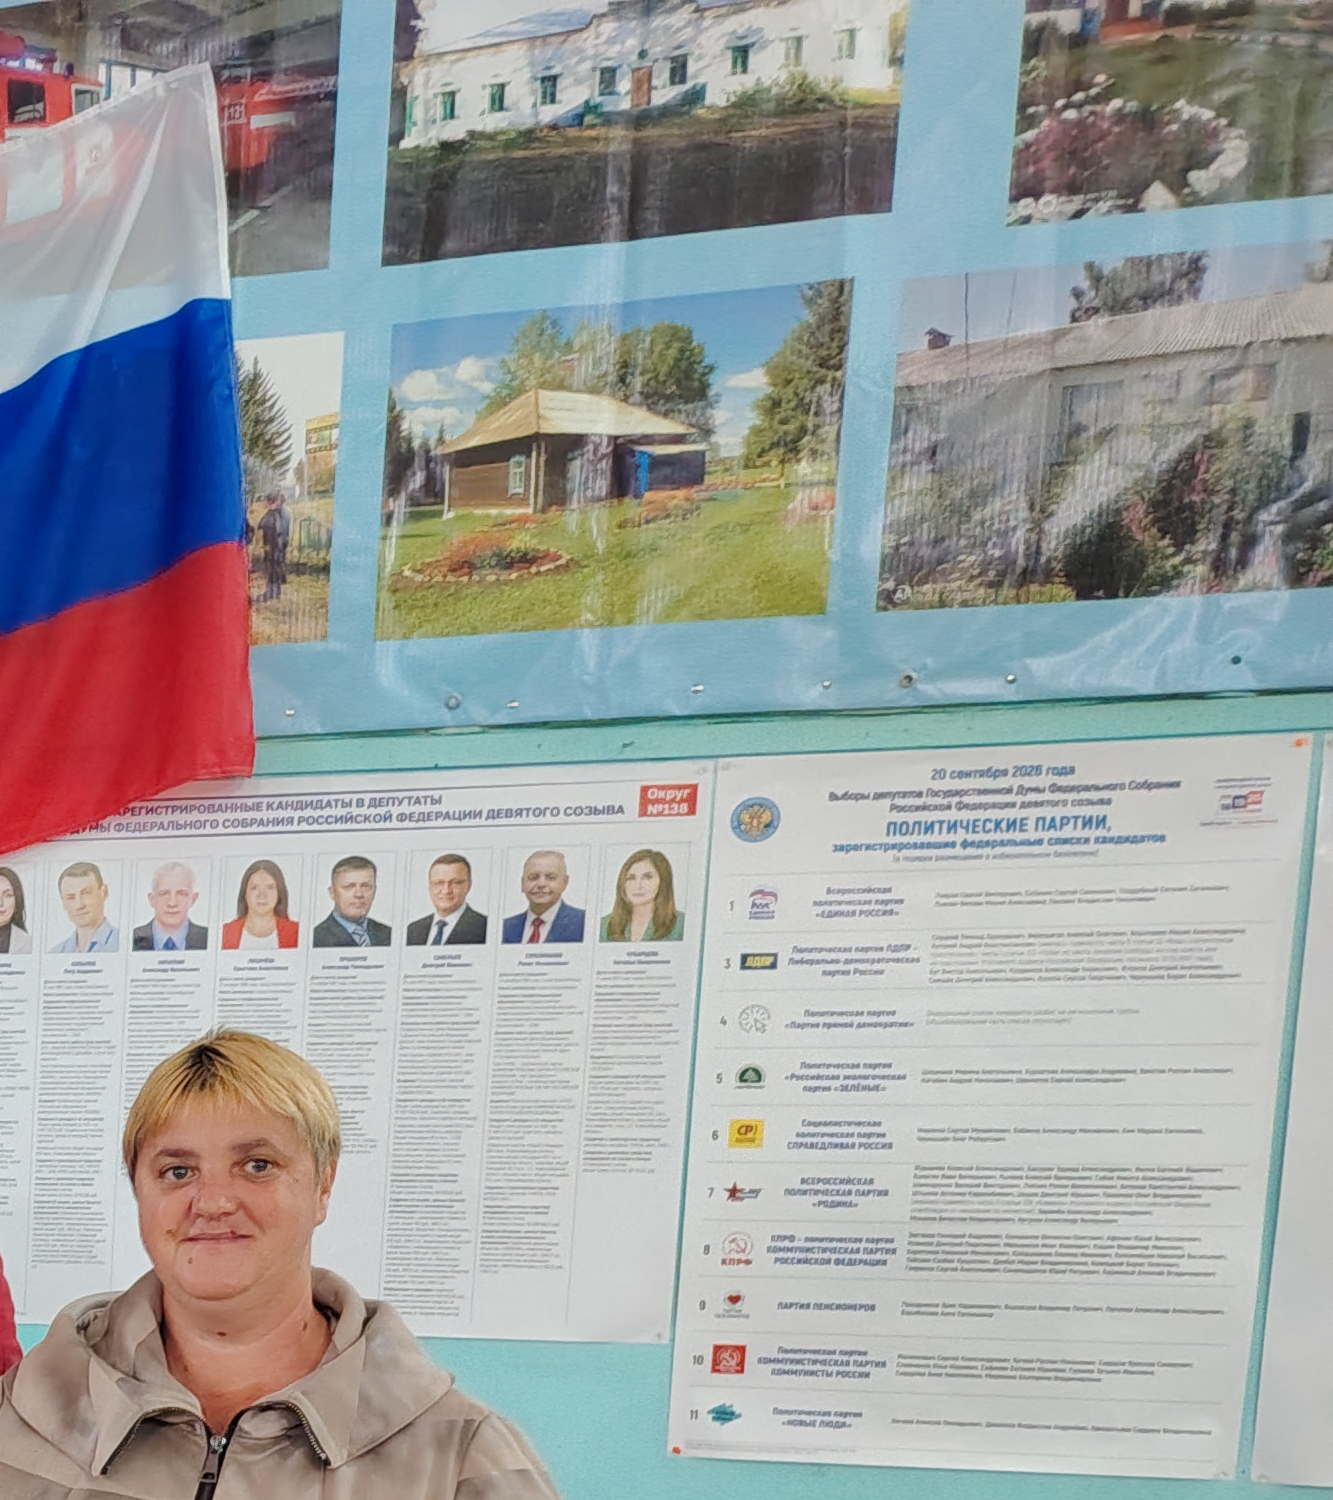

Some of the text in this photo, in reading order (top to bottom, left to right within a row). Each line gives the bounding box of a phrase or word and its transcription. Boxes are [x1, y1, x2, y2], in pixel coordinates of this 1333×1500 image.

[930, 768, 946, 781] 20
[949, 766, 1008, 781] сентября
[1045, 765, 1076, 778] года
[646, 788, 691, 801] Округ
[828, 790, 871, 803] Выборы
[925, 785, 1014, 800] Государственной
[1015, 784, 1046, 797] Думы
[1048, 780, 1126, 794] Федерального
[1127, 779, 1182, 792] Собрания
[113, 794, 443, 818] РЕГИСТРИРОВАННЫЕ КАНДИДАТЫ В ДЕПУТАТЫ
[889, 801, 952, 814] Российской
[954, 800, 1017, 812] Федерации
[113, 818, 220, 835] ФЕДЕРАЛЬНОГО
[222, 815, 295, 830] СОБРАНИЯ
[297, 811, 393, 827] РОССИЙСКОЙ
[396, 809, 483, 824] ФЕДЕРАЦИИ
[485, 806, 561, 821] ДЕВЯТОГО
[563, 804, 625, 818] СОЗЫВА
[885, 814, 1112, 837] ПОЛИТИЧЕСКИЕ ПАРТИИ,
[832, 832, 1167, 855] зарегистрировавшие федеральные списки кандидатов
[729, 901, 735, 912] 1
[724, 958, 731, 970] 3
[720, 1016, 728, 1027] 4
[716, 1073, 723, 1085] 5
[711, 1130, 720, 1141] 6
[707, 1187, 715, 1199] 7
[721, 1258, 753, 1267] КПРФ
[692, 1355, 705, 1366] 10
[689, 1409, 699, 1421] 11
